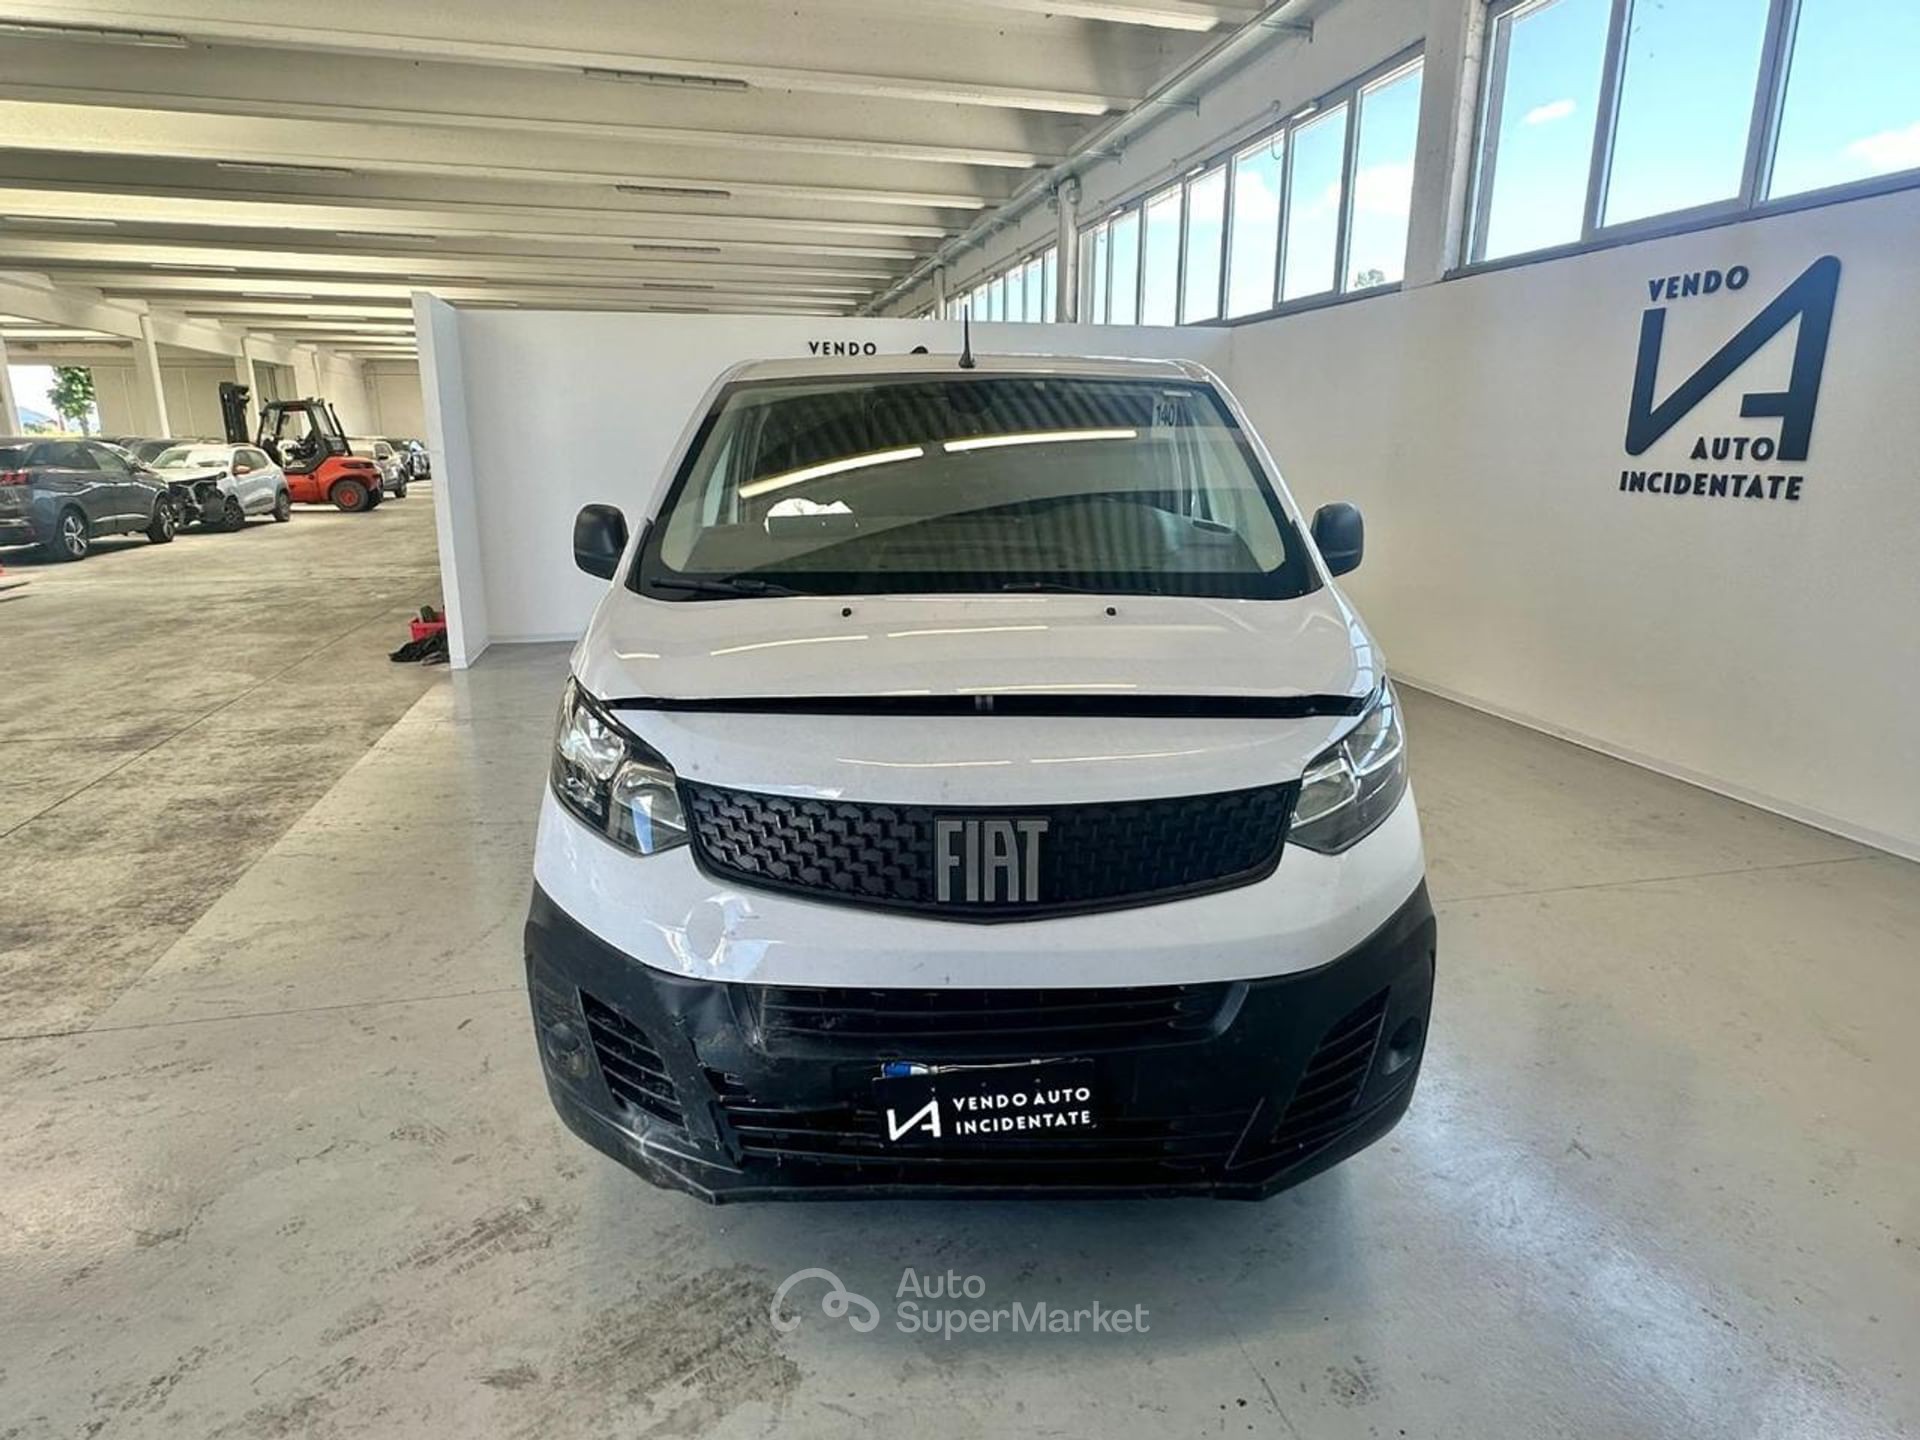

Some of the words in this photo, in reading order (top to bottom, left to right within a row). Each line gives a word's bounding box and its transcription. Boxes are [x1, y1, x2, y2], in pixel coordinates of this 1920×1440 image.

[1649, 265, 1750, 301] VENDO
[808, 341, 877, 356] VENDO
[1690, 436, 1775, 460] AUTO
[1619, 471, 1804, 501] INCIDENTATE
[937, 820, 1049, 902] FIAT
[952, 1093, 1028, 1111] VENDO
[1033, 1087, 1091, 1106] AUTO
[955, 1110, 1091, 1135] INCIDENTATE
